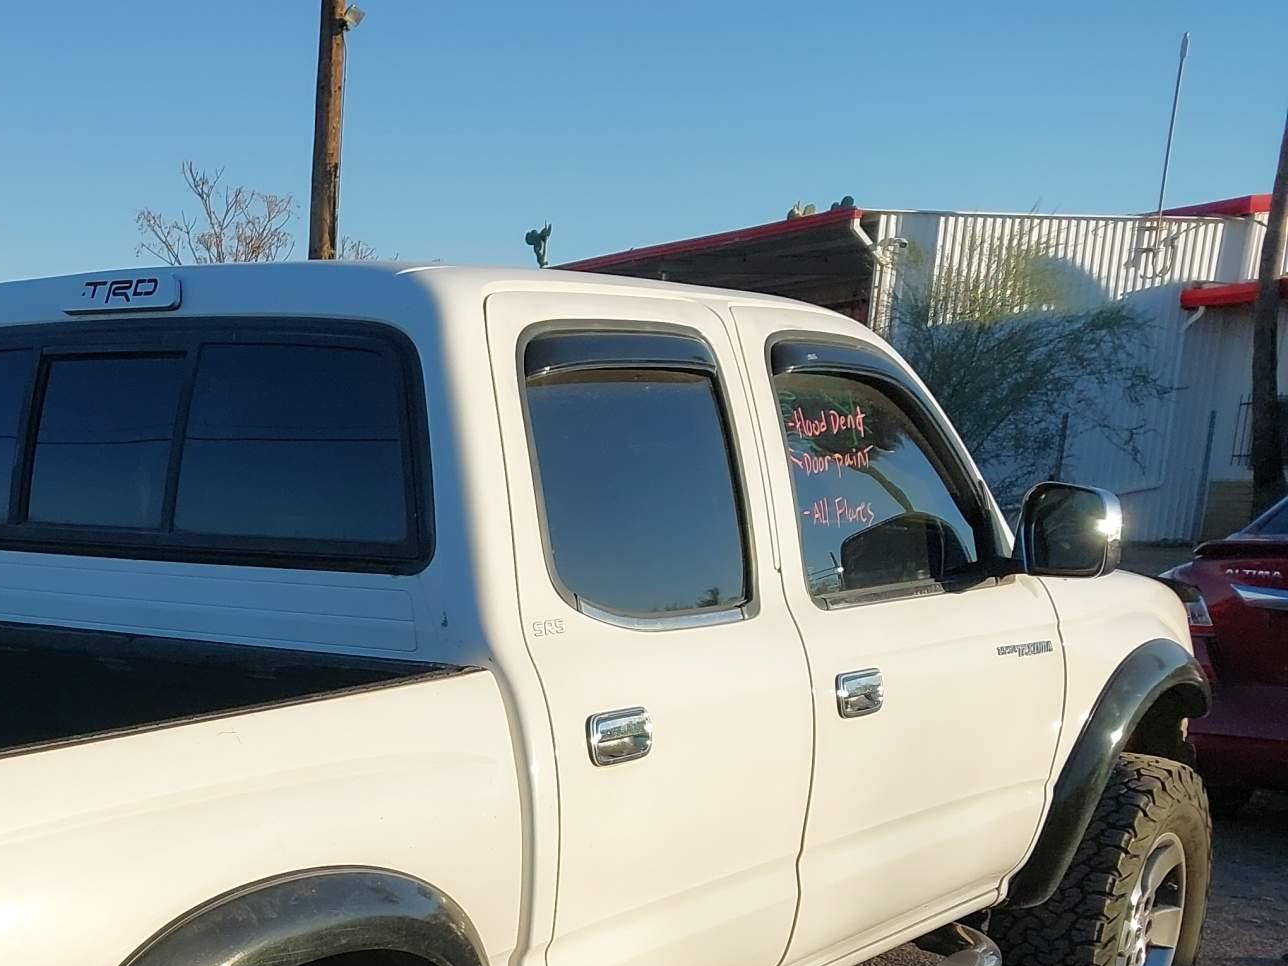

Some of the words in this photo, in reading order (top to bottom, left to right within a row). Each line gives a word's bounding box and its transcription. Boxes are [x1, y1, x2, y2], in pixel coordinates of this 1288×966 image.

[82, 278, 159, 304] TRD
[829, 405, 866, 438] Dent
[833, 444, 874, 479] paint
